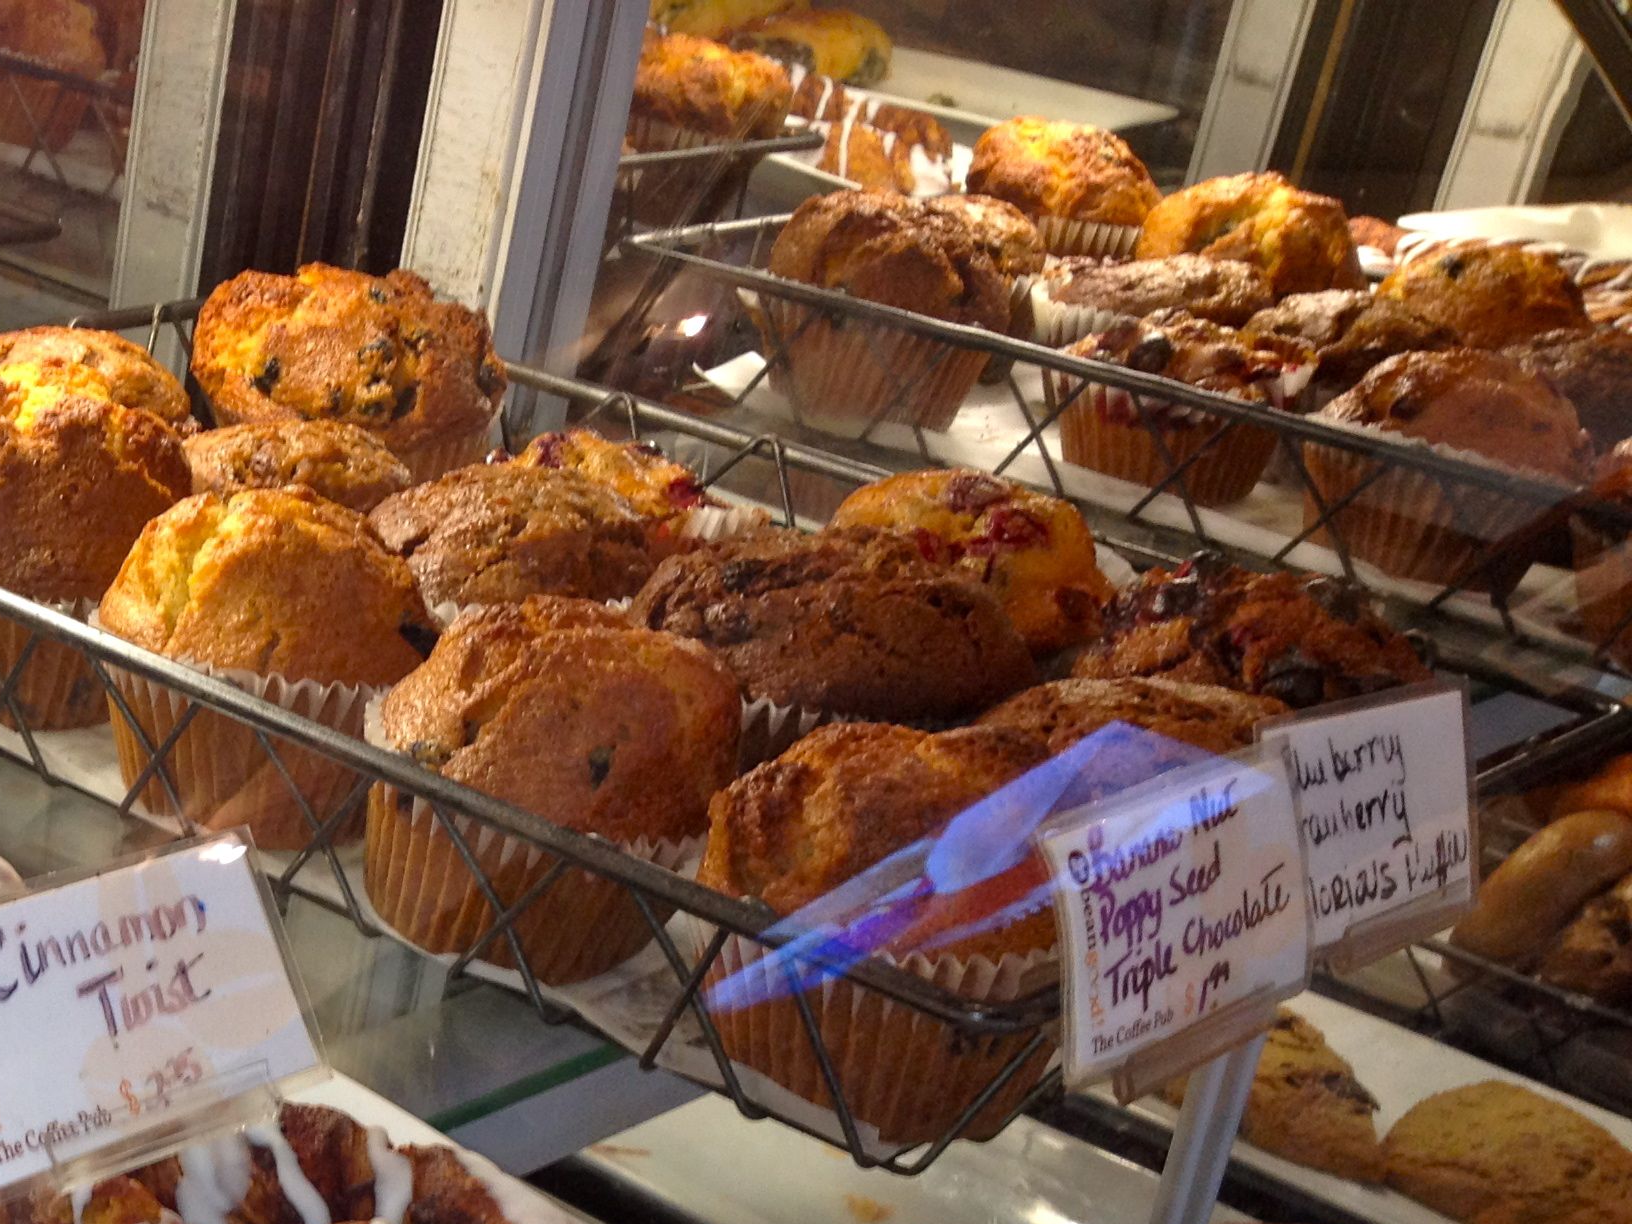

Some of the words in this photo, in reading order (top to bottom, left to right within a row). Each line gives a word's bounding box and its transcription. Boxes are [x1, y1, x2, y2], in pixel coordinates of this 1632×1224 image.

[1292, 733, 1407, 788] lueberry
[1099, 884, 1164, 949] Poppy
[1168, 839, 1223, 907] Seed
[1103, 945, 1179, 1014] Triple
[1181, 862, 1291, 957] Chocolate
[76, 952, 212, 1049] Twist
[1091, 1033, 1114, 1056] The
[1116, 1017, 1152, 1043] Coffee
[1152, 1006, 1175, 1030] Pub
[24, 1117, 81, 1151] Coffee
[77, 1103, 113, 1135] Pub
